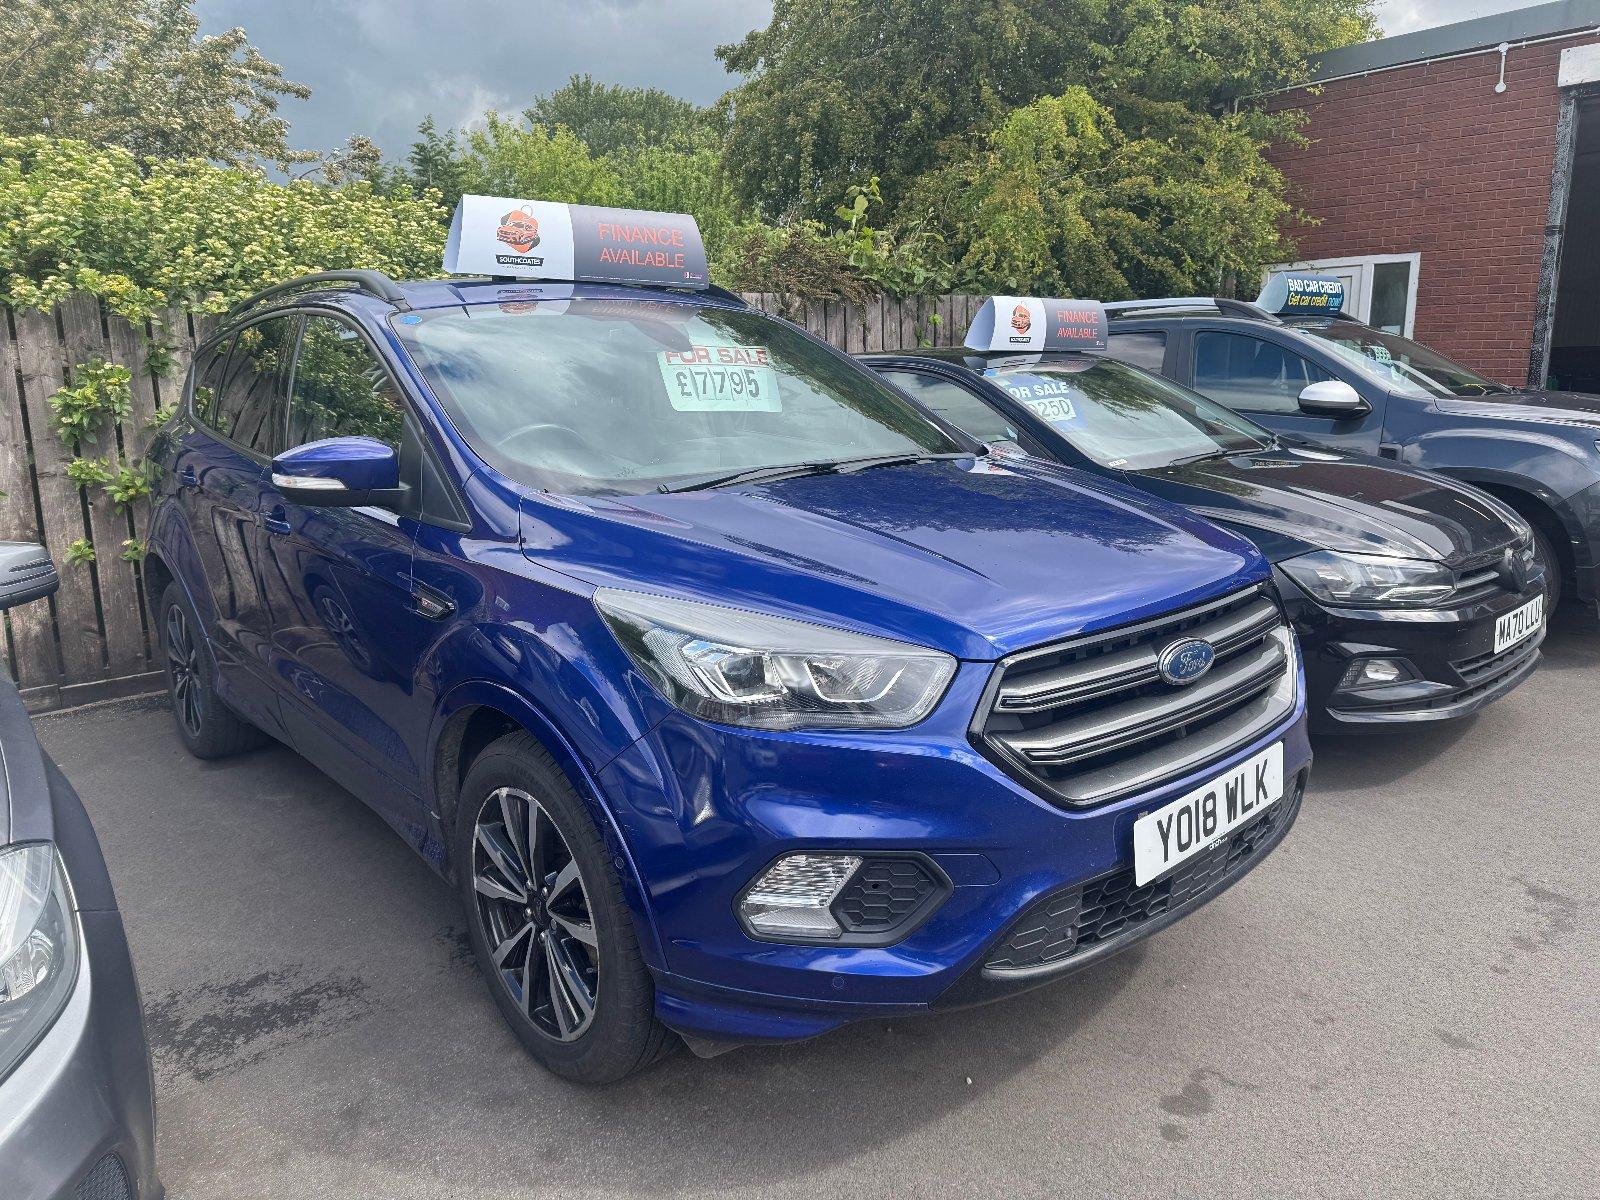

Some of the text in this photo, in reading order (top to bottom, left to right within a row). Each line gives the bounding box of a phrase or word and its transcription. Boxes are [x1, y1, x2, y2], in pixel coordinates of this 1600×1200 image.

[598, 223, 684, 247] FINANCE
[499, 256, 541, 264] SOUTHCOATES
[600, 247, 685, 268] AVAILABLE
[1288, 279, 1342, 294] BAD CAR CREDIT
[1288, 292, 1300, 305] Get
[1300, 296, 1311, 306] car
[1311, 294, 1328, 307] credit
[1057, 311, 1098, 323] FINANCE
[1057, 328, 1098, 338] AVAILABLE
[665, 348, 768, 365] FOR SALE
[675, 369, 760, 398] £7795
[1008, 382, 1070, 398] OR SALE
[1498, 610, 1524, 646] MA70
[1180, 650, 1206, 674] Ford
[1156, 759, 1269, 863] YO18 WLK
